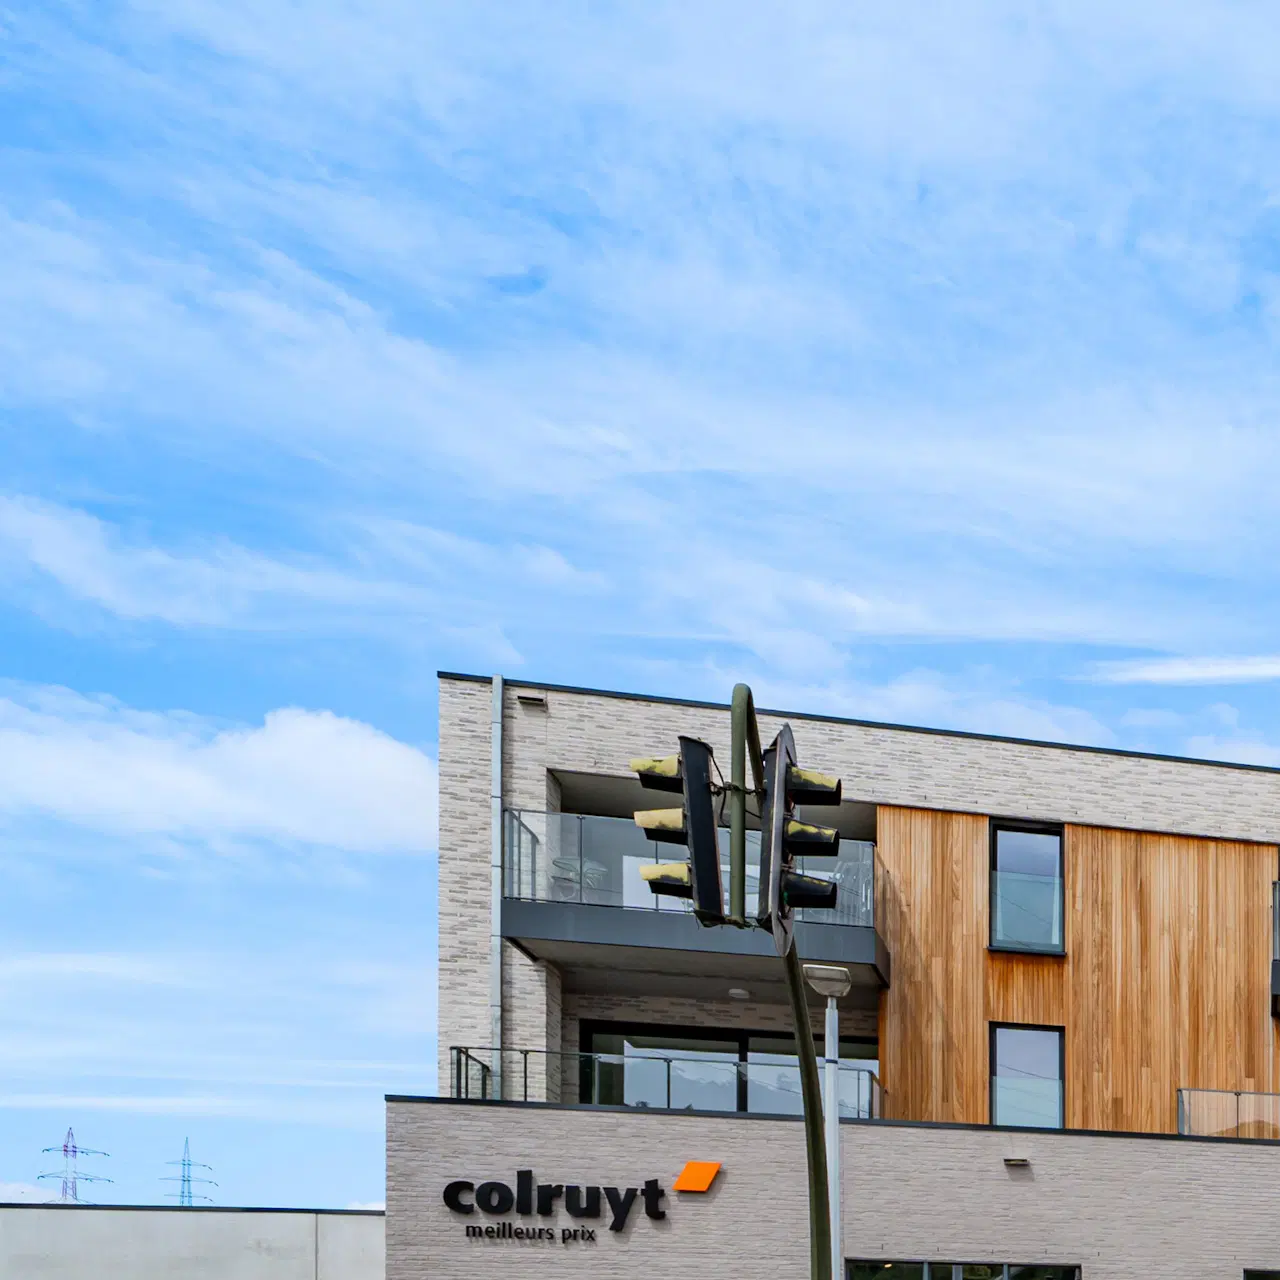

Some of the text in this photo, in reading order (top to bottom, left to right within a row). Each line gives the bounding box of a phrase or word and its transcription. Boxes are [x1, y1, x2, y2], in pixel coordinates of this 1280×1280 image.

[443, 1170, 666, 1232] colruyt
[465, 1222, 595, 1244] meilleurs prix
